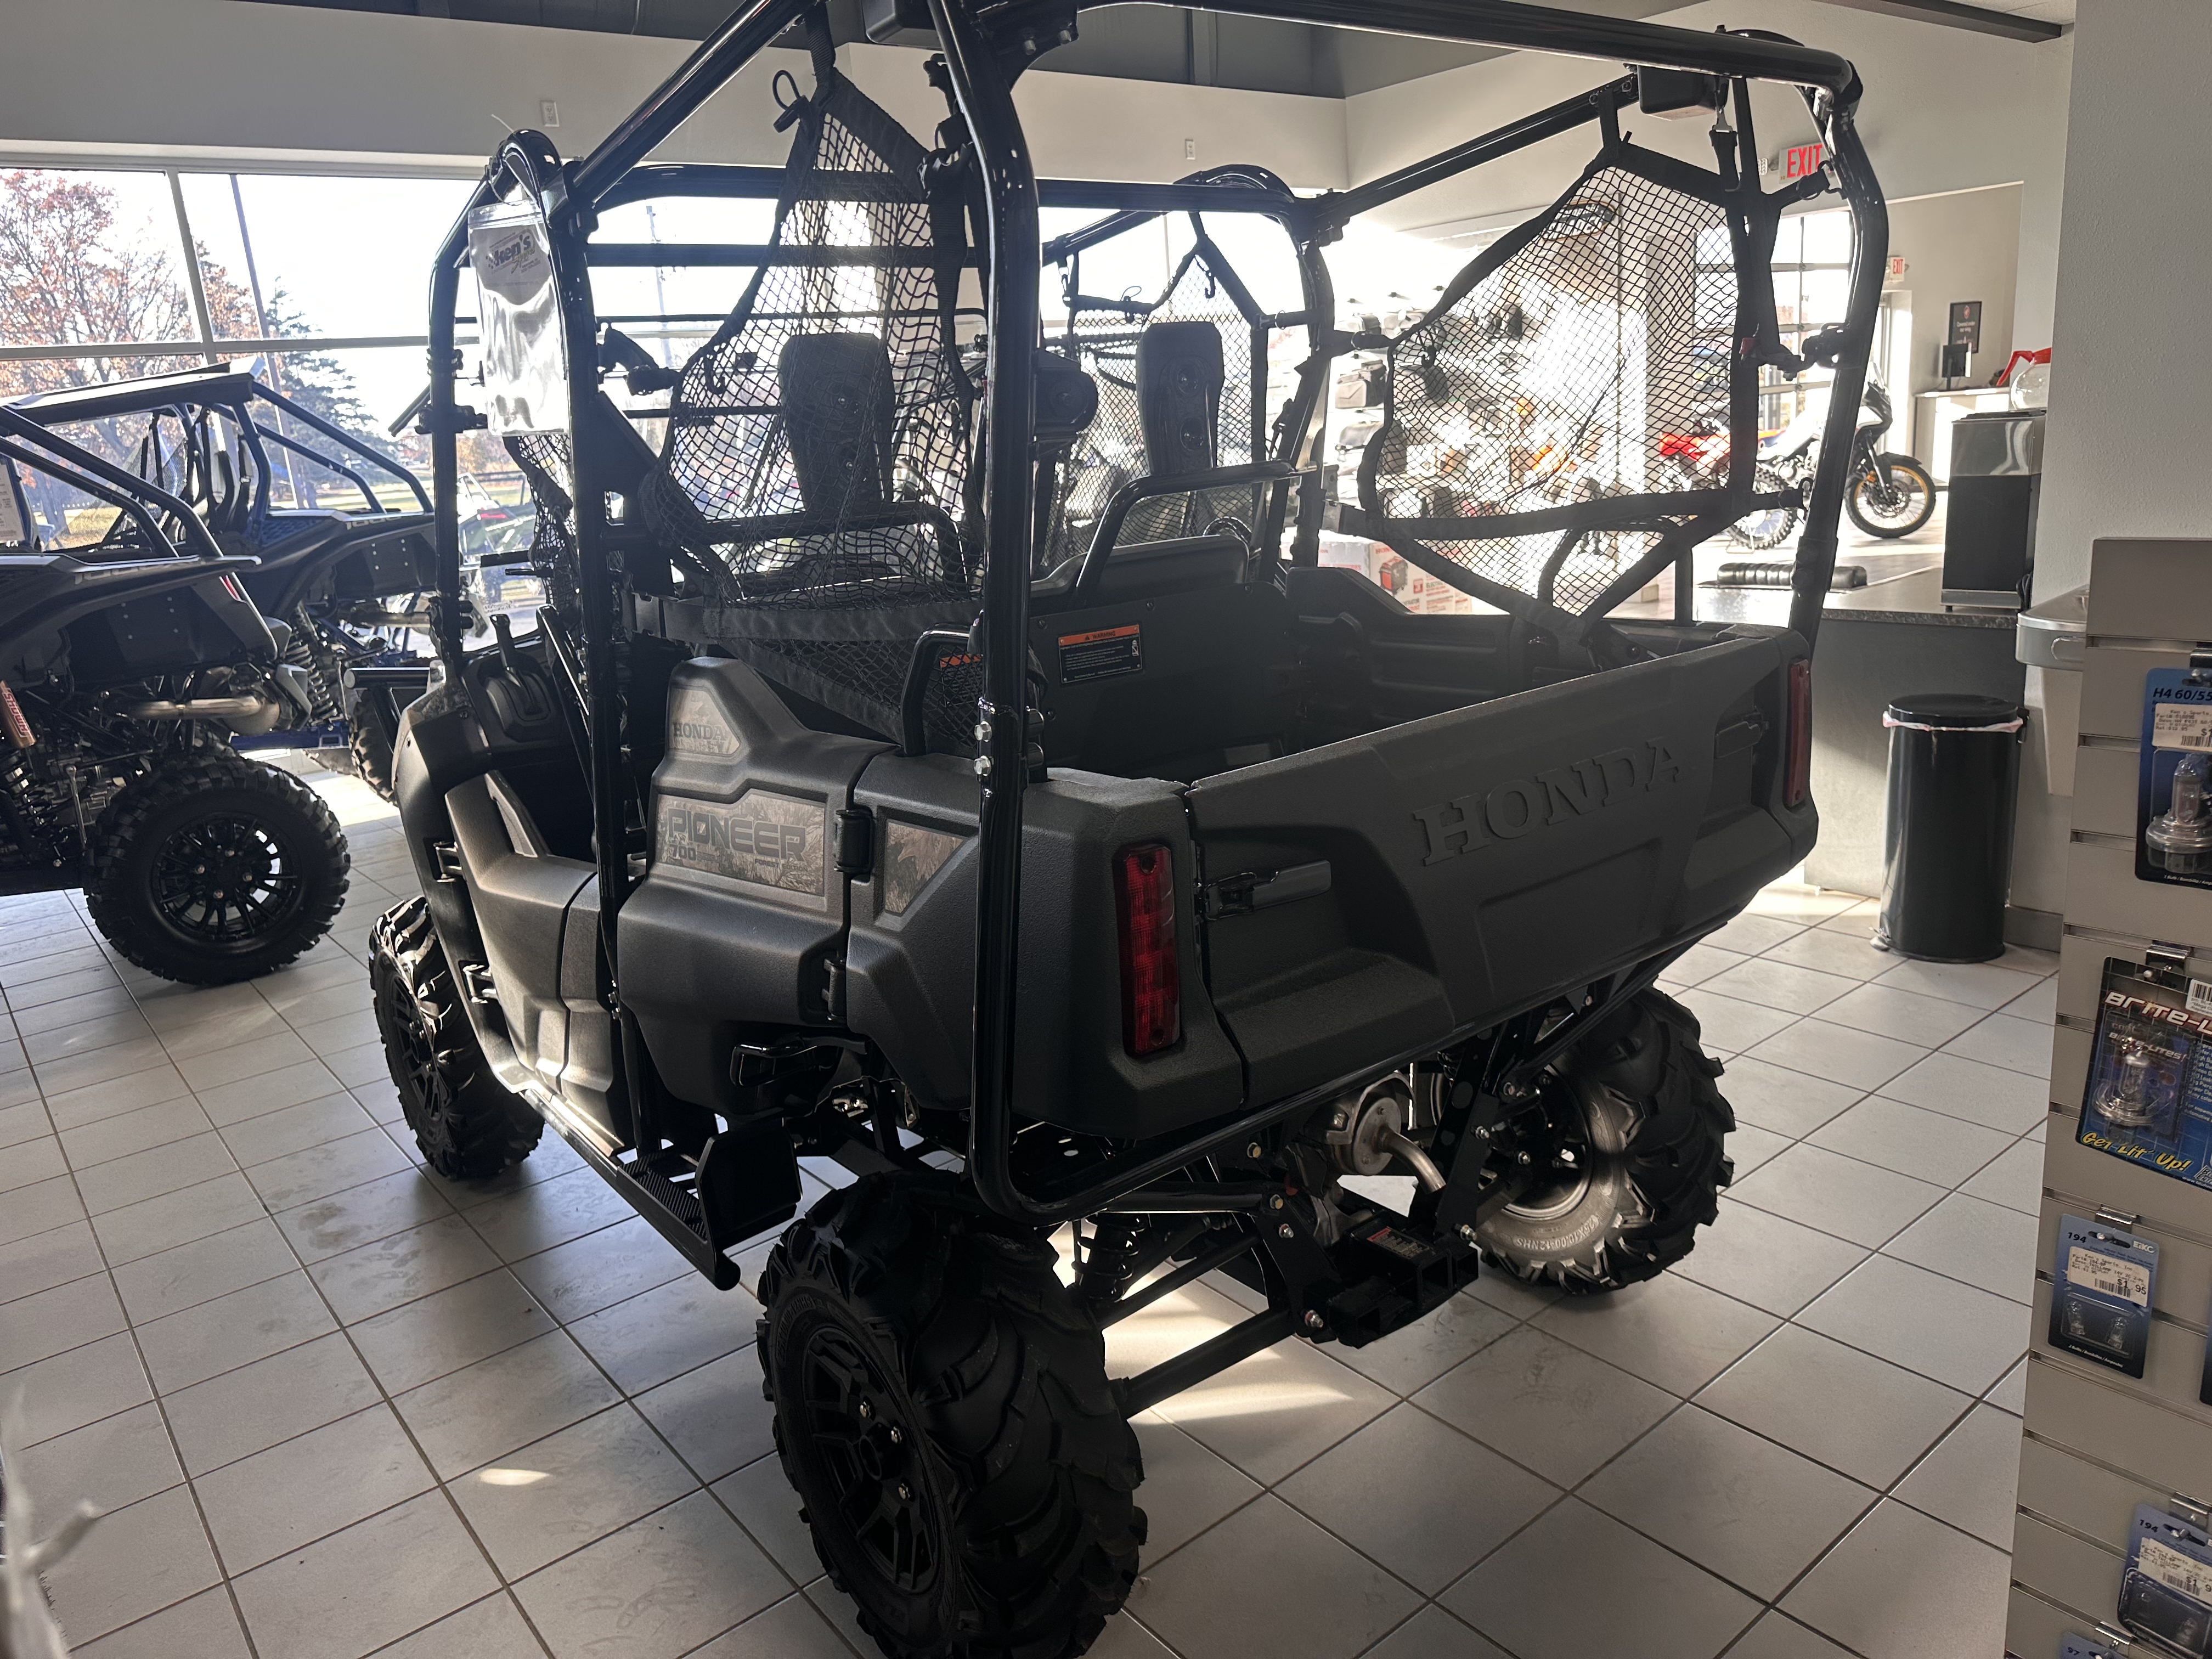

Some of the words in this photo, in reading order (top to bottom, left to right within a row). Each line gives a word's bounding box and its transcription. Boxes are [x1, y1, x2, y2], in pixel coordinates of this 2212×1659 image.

[1787, 144, 1822, 178] EXIT
[494, 234, 531, 267] ken's
[1893, 258, 1903, 274] EXIT
[1093, 631, 1116, 639] WARNING
[2153, 687, 2172, 698] H4
[673, 722, 727, 741] HONDA
[1413, 737, 1680, 866] HONDA
[667, 808, 806, 862] PIONEER
[669, 844, 697, 861] 700
[755, 859, 780, 868] FOREST
[782, 864, 808, 872] EDITION
[2155, 1153, 2191, 1171] Up!
[2068, 1232, 2087, 1244] 194
[2085, 1254, 2099, 1262] Kens
[2140, 1519, 2158, 1533] 194
[2067, 1646, 2080, 1656] 97
